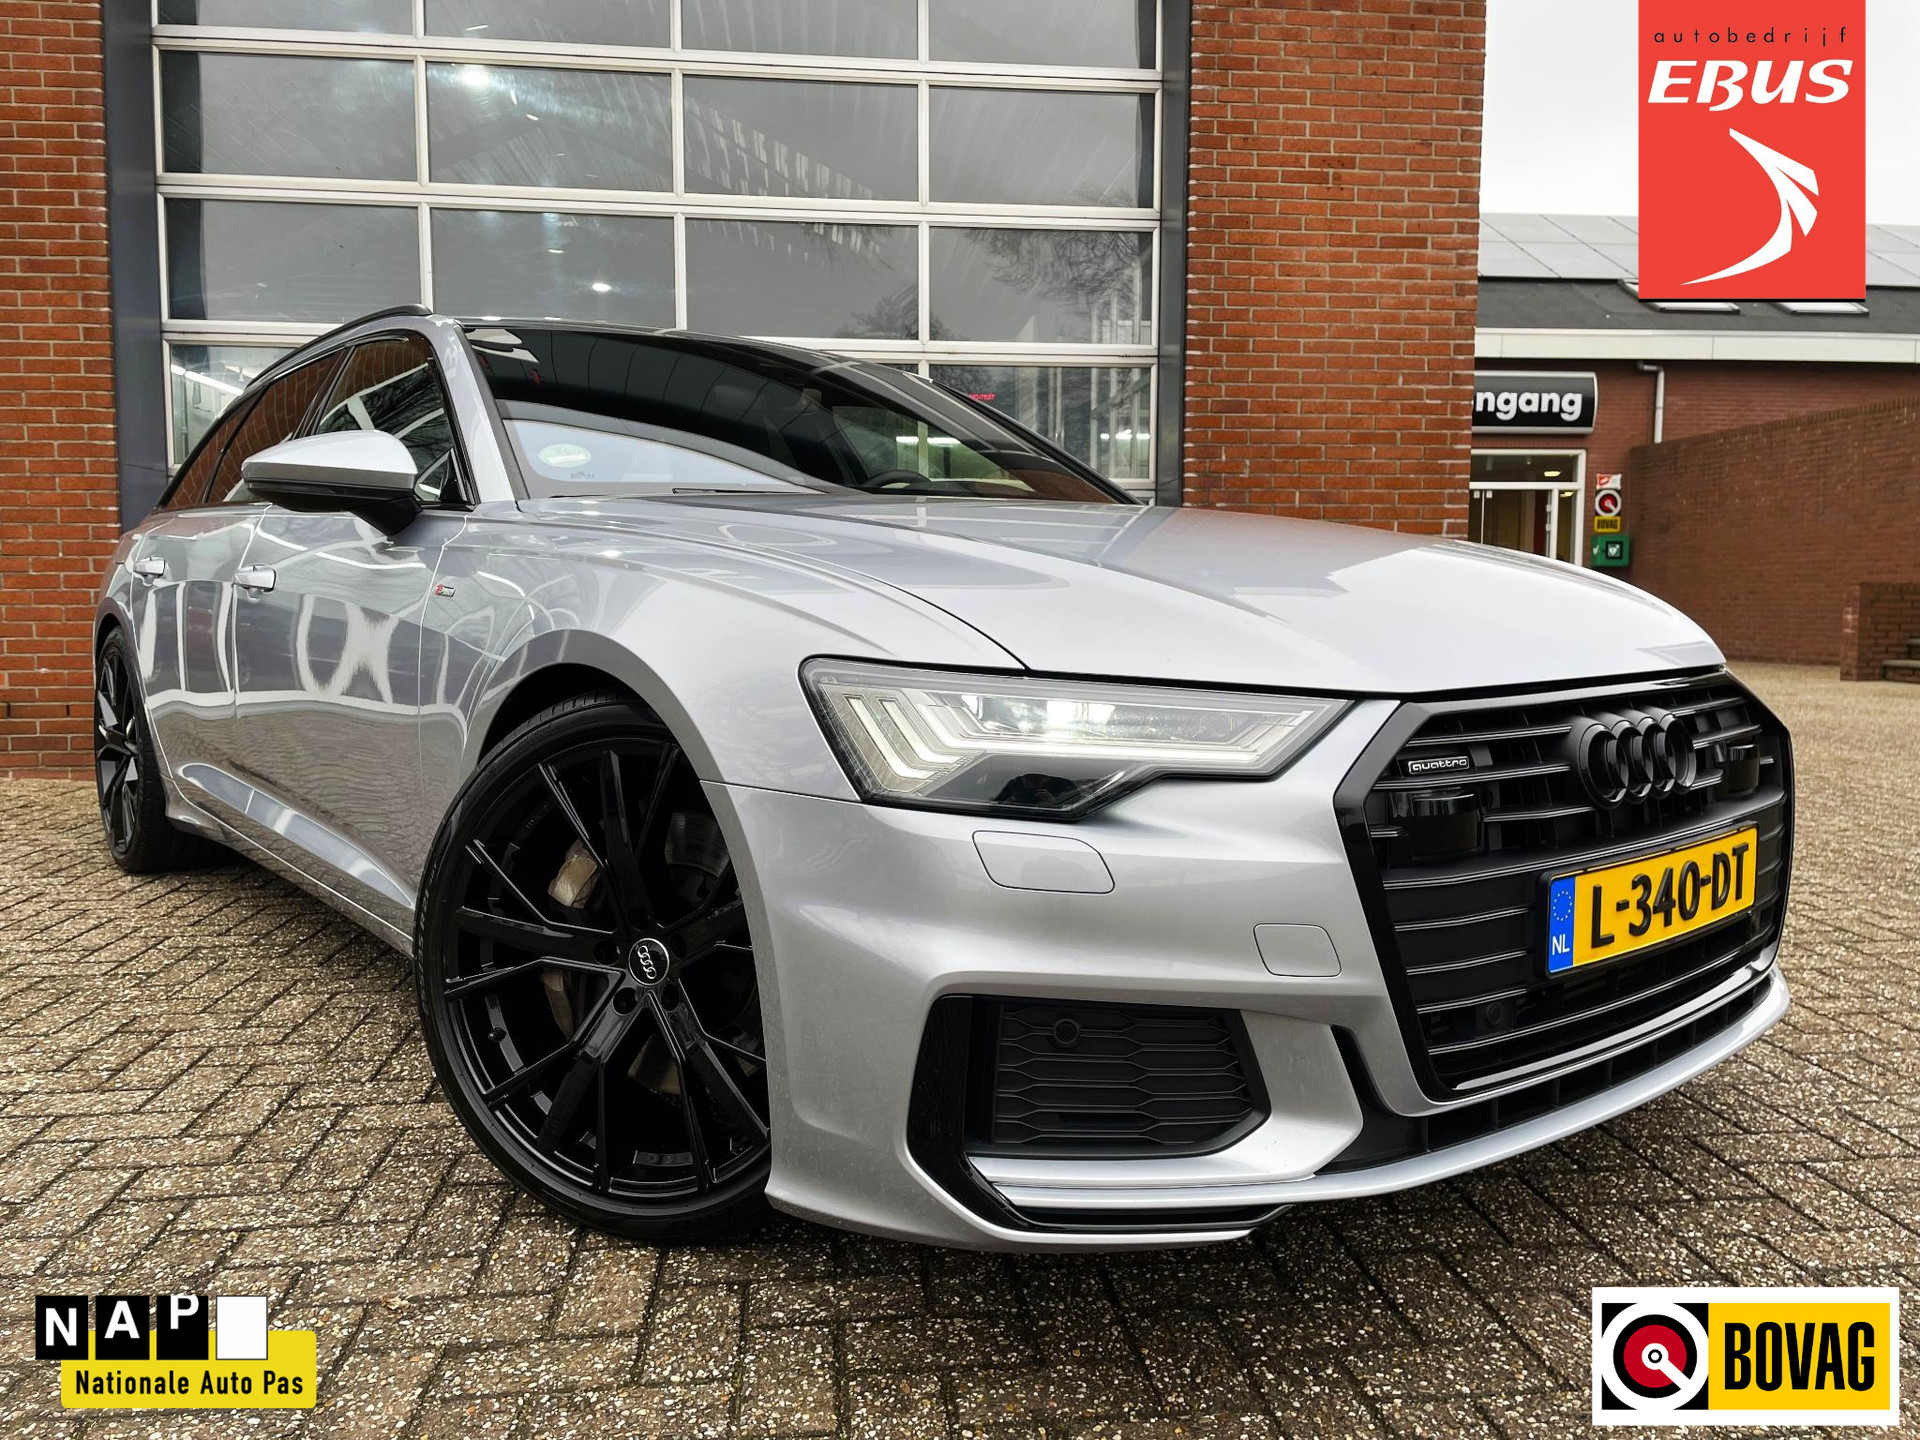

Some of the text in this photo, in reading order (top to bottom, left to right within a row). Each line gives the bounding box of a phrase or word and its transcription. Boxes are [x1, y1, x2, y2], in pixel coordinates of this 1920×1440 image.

[1475, 391, 1583, 422] ngang
[1412, 759, 1467, 772] quattro
[1591, 842, 1749, 949] L-340-DT
[1552, 933, 1570, 956] NL
